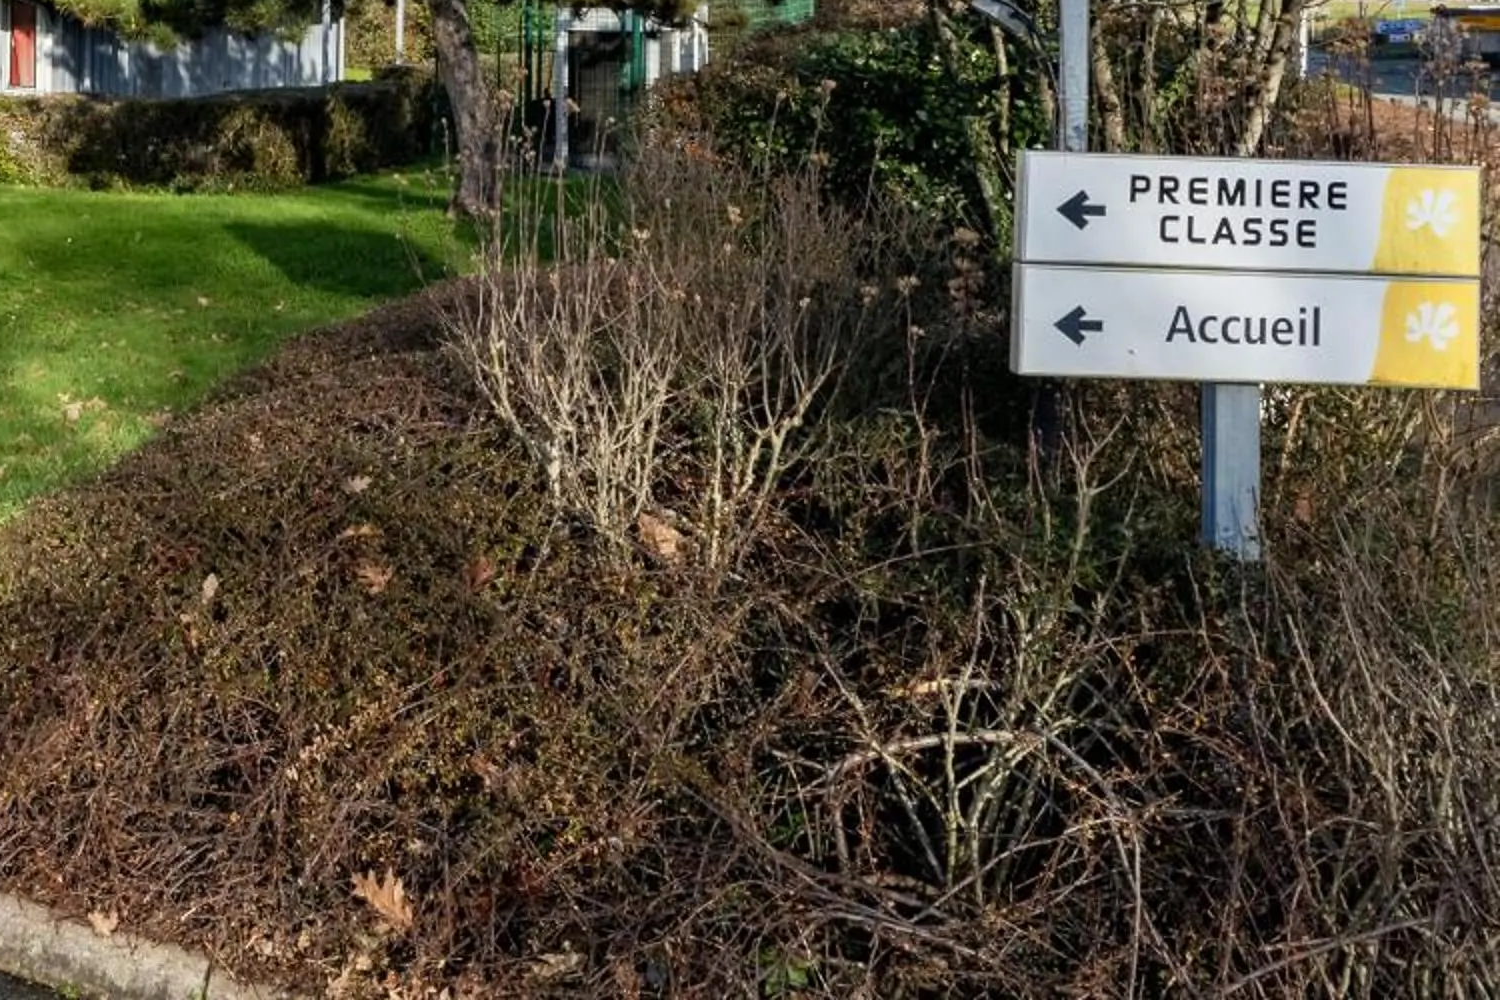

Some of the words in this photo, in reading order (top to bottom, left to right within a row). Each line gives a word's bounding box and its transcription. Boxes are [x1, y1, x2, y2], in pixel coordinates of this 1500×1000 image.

[1130, 174, 1347, 210] PREMIERE
[1159, 215, 1317, 248] CLASSE
[1166, 305, 1320, 346] Accueil
